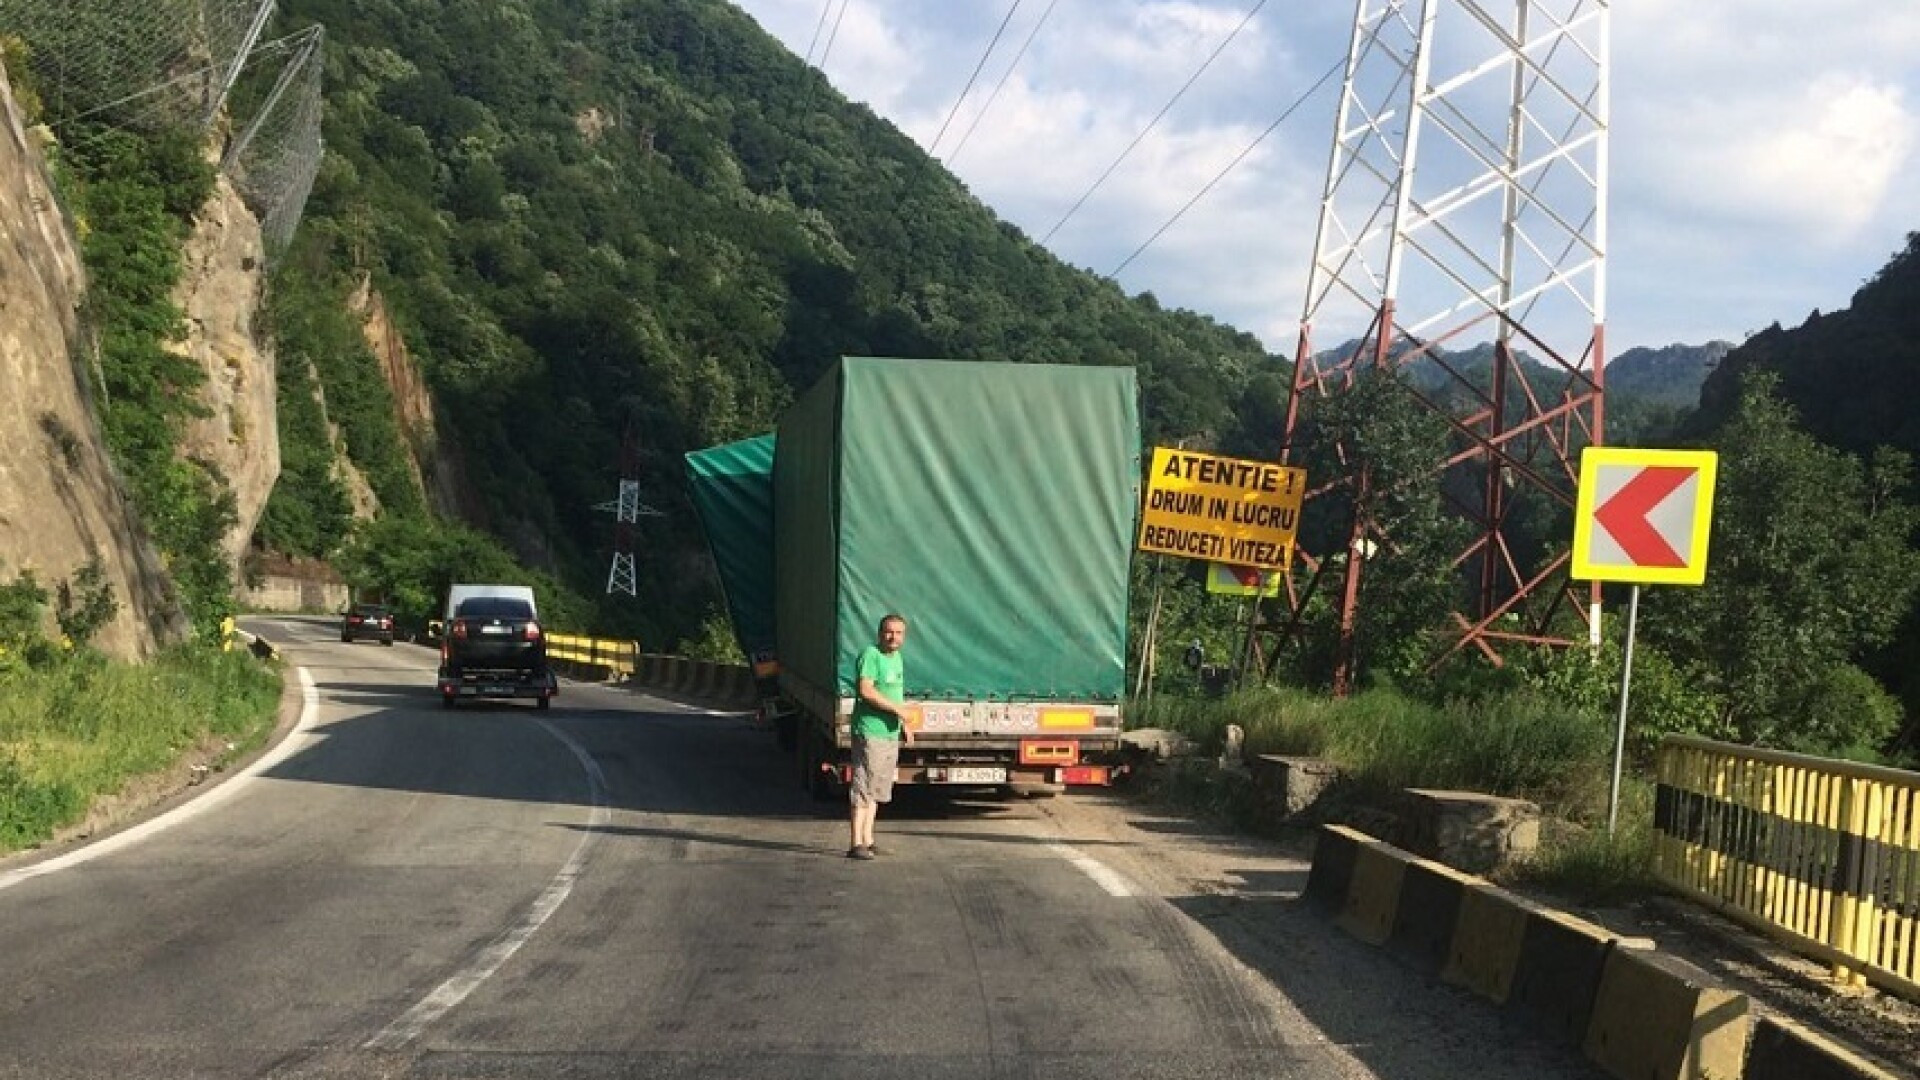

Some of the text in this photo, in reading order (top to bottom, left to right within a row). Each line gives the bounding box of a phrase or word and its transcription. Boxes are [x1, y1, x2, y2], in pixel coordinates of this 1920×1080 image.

[1164, 455, 1295, 495] ATENTIE !
[1151, 489, 1294, 531] DRUM IN LUCRU
[1144, 525, 1285, 567] REDUCETI VITEZA
